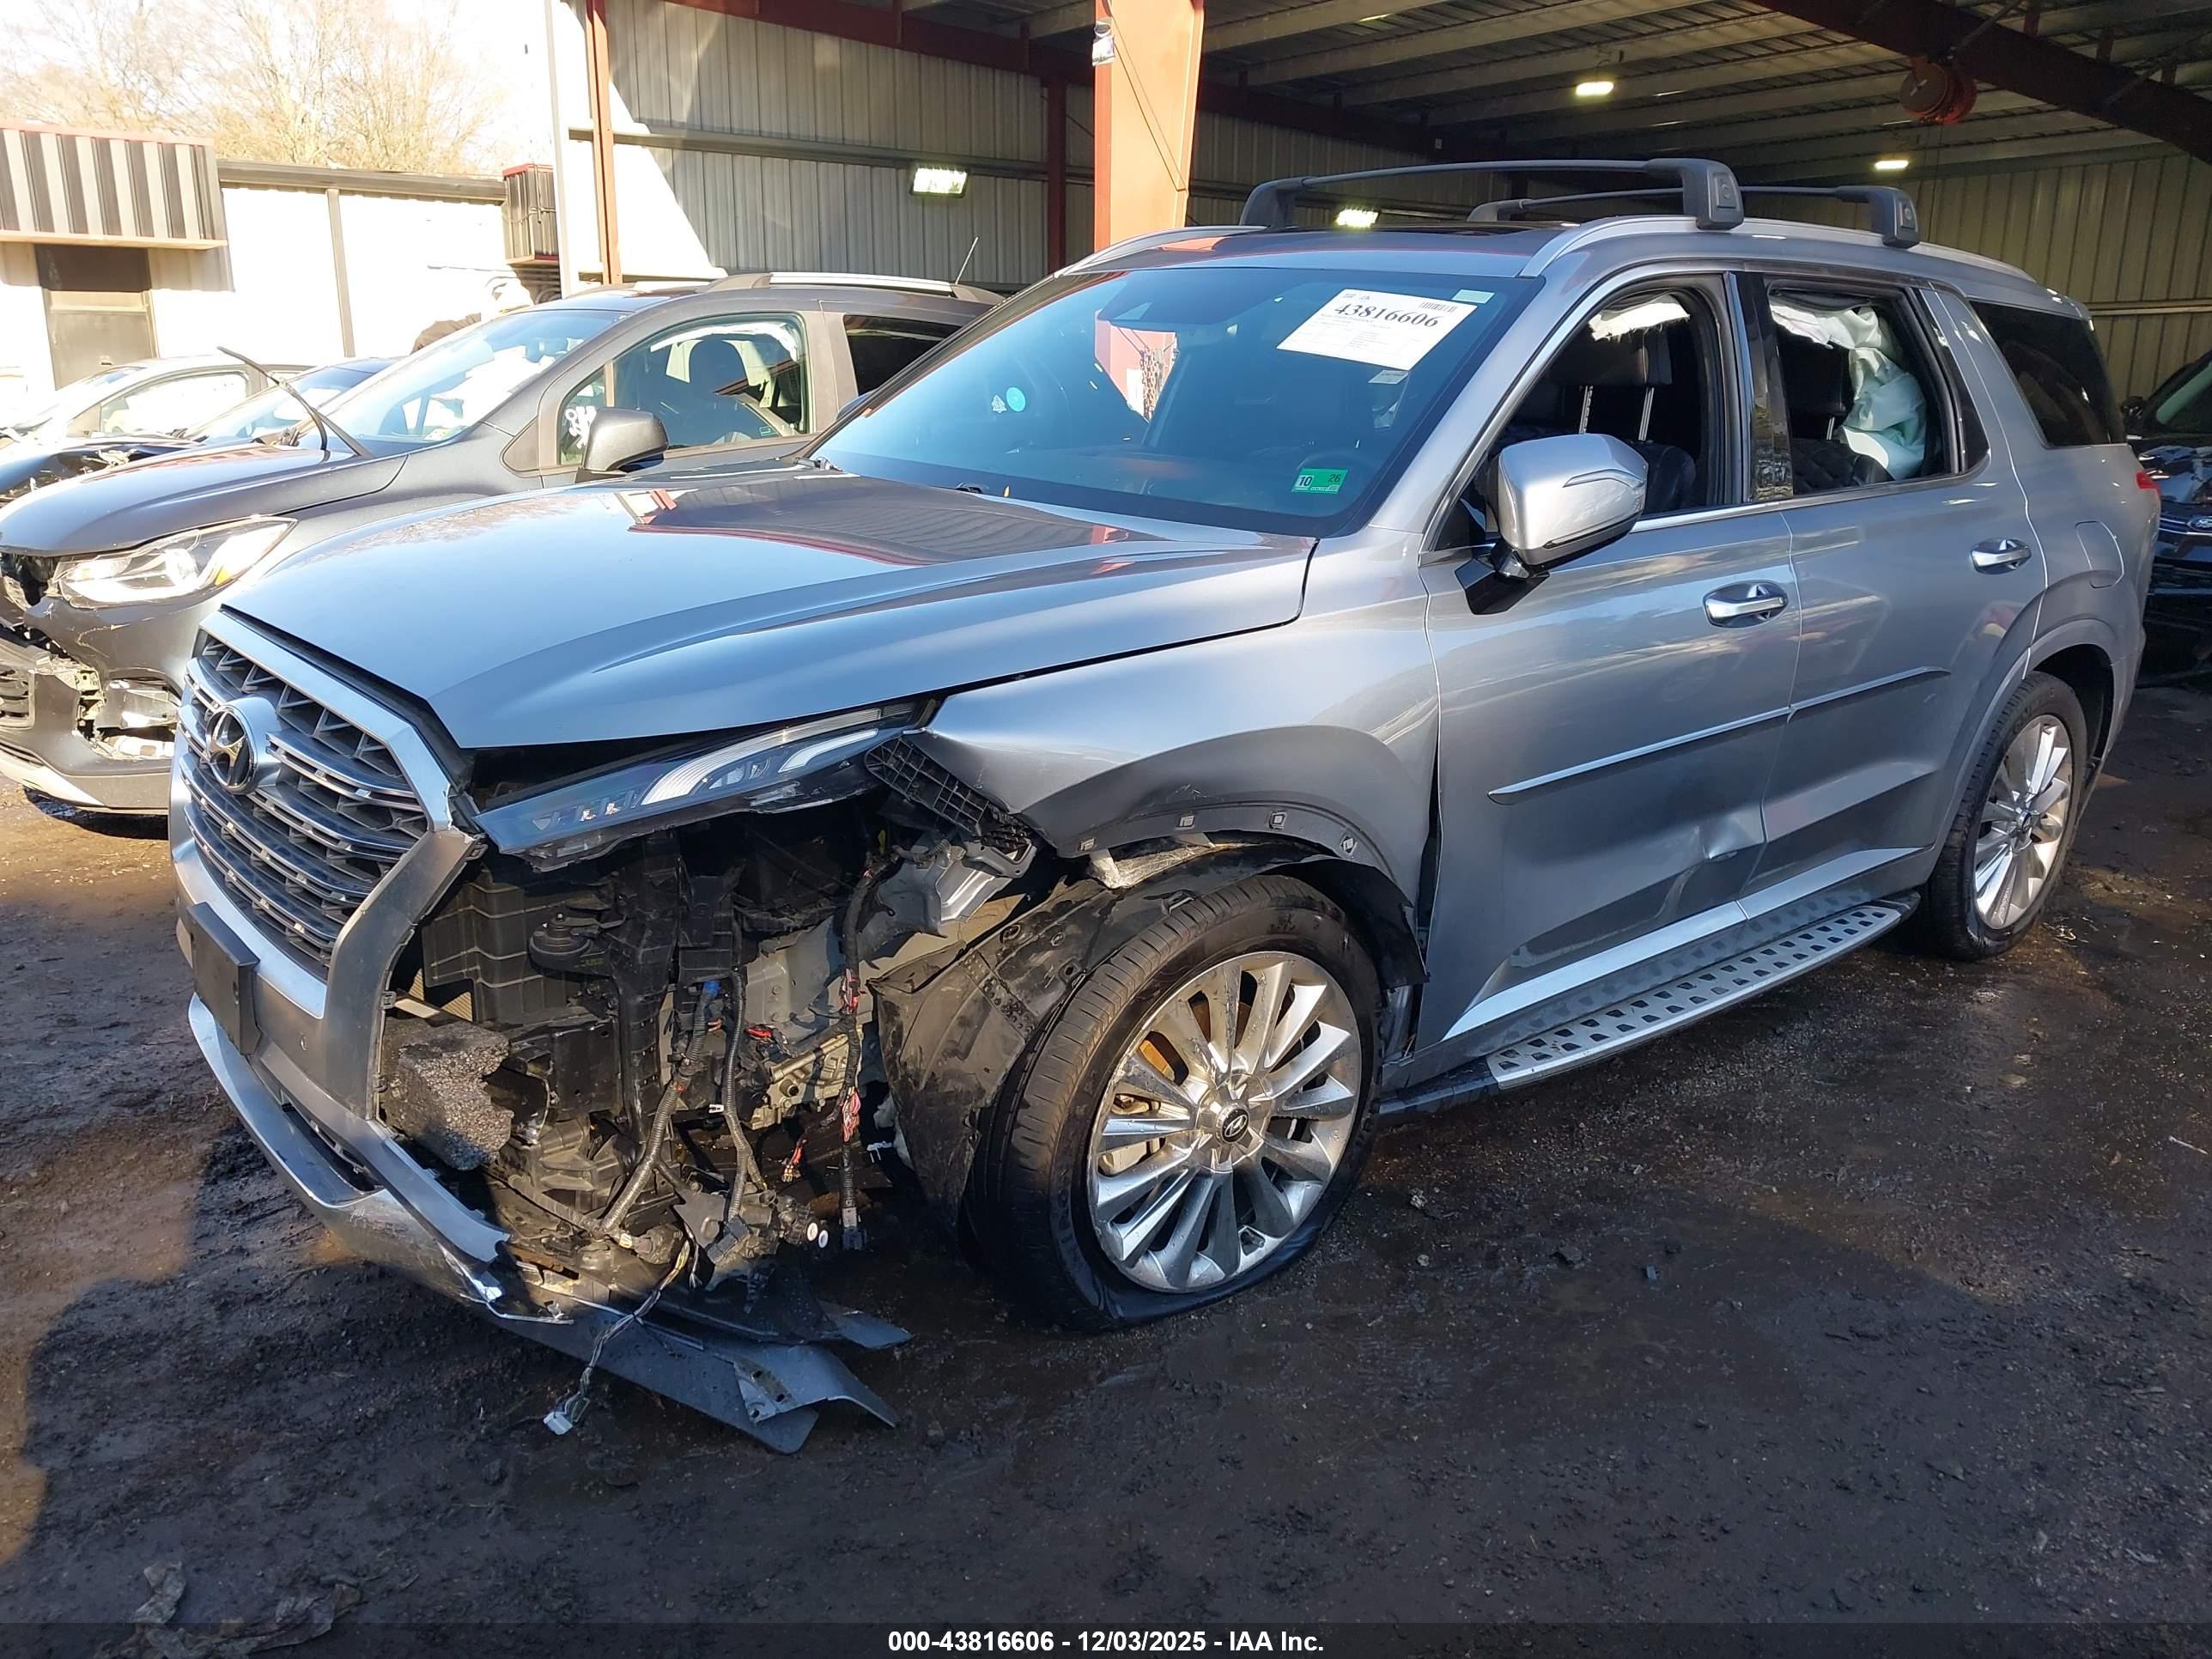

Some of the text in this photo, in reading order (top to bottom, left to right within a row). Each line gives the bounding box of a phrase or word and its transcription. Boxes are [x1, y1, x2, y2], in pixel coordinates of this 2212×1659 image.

[1334, 303, 1443, 327] 43816606
[1298, 473, 1342, 487] 10 26
